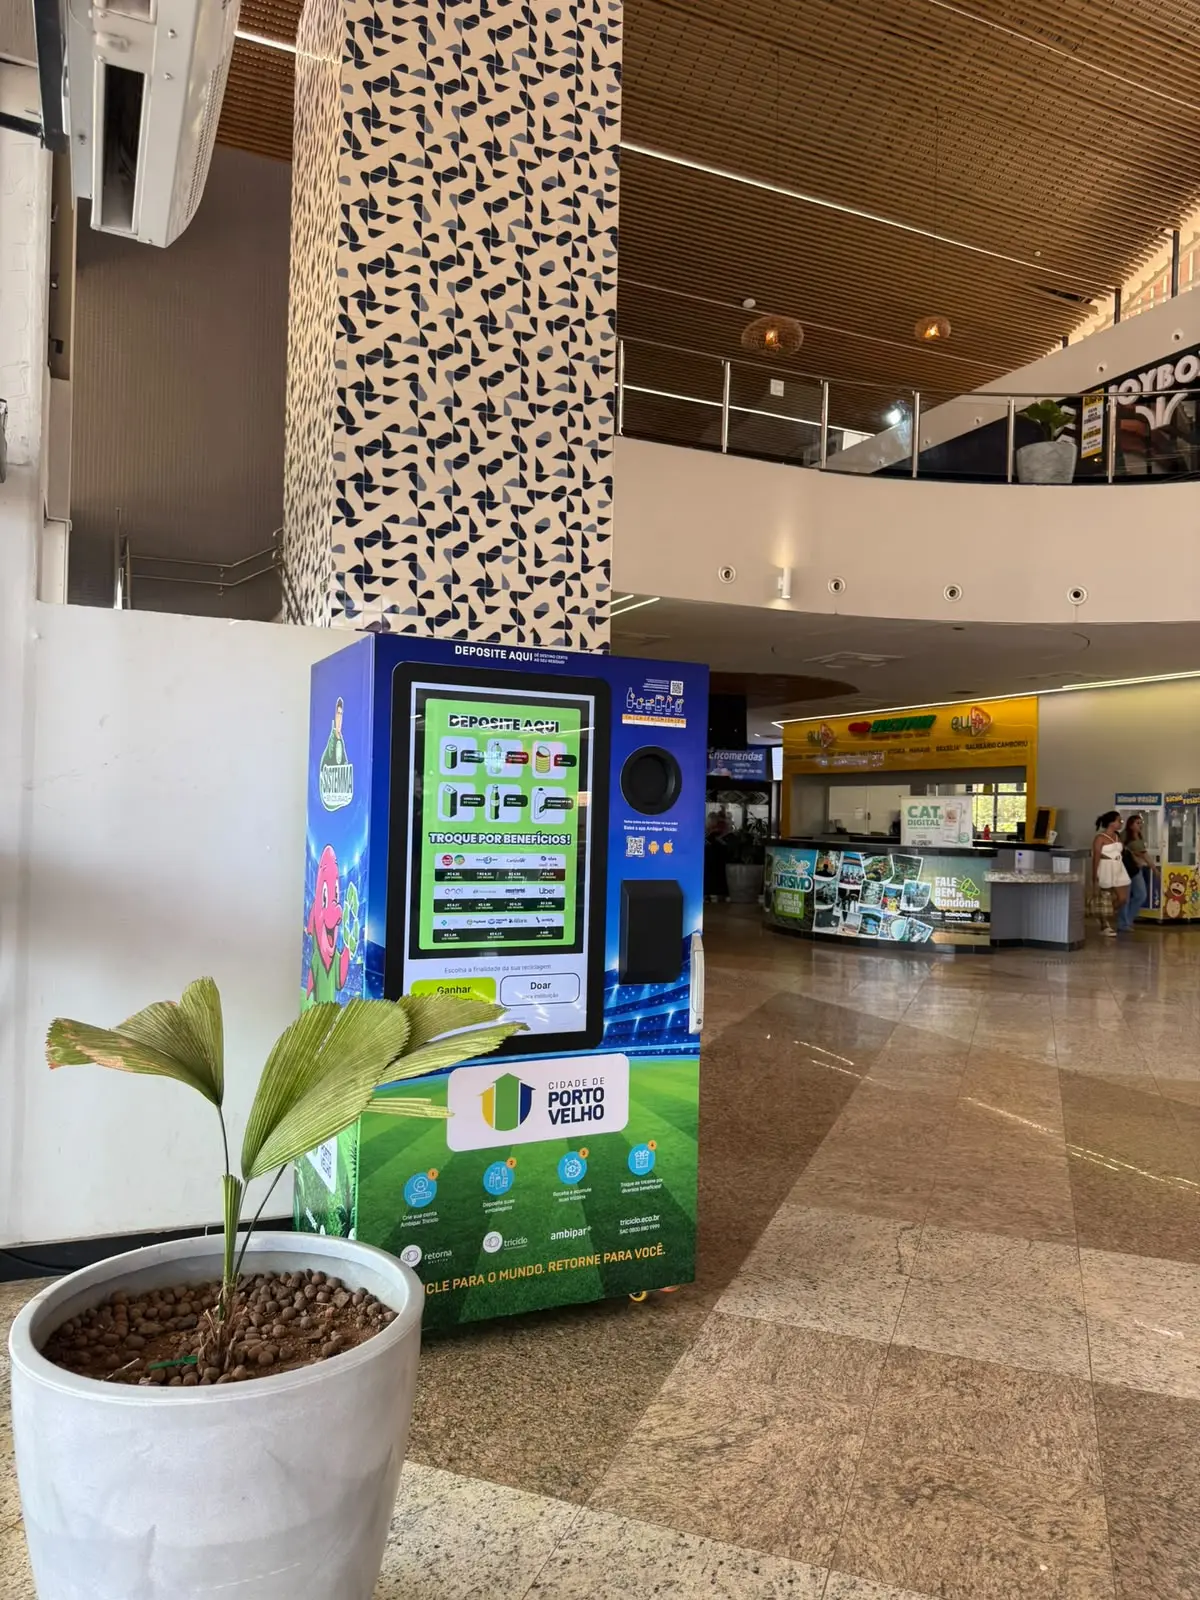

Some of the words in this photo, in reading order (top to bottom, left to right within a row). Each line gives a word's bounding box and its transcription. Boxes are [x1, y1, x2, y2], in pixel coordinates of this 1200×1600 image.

[1106, 350, 1200, 412] JOYBO
[455, 645, 507, 659] DEPOSITE
[508, 651, 533, 661] AQUI
[449, 714, 521, 732] DEPOSITE
[523, 719, 560, 734] AQUI
[429, 832, 477, 845] TROQUE
[479, 833, 502, 844] POR
[503, 830, 571, 845] BENEFÍCIOS!
[935, 877, 957, 887] FALE
[538, 887, 556, 895] Uber
[935, 887, 956, 897] BEM
[935, 897, 980, 908] Rondônia
[444, 966, 467, 974] Escolha
[473, 965, 500, 973] finalidade
[437, 985, 472, 995] Ganhar
[530, 981, 552, 990] Doar
[548, 1078, 588, 1090] CIDADE
[592, 1077, 605, 1085] DE
[548, 1087, 605, 1108] PORTO
[548, 1104, 605, 1126] VELHO
[482, 1200, 503, 1208] Deposite
[400, 1219, 421, 1228] Ambipar
[619, 1214, 661, 1226] triciclo.eco.br
[504, 1236, 528, 1247] triciclo
[424, 1250, 452, 1260] retorna
[452, 1273, 485, 1290] PARA
[487, 1272, 496, 1283] O
[499, 1263, 545, 1280] MUNDO.
[548, 1254, 601, 1272] RETORNE
[603, 1249, 633, 1264] PARA
[634, 1242, 666, 1258] VOCÊ.
